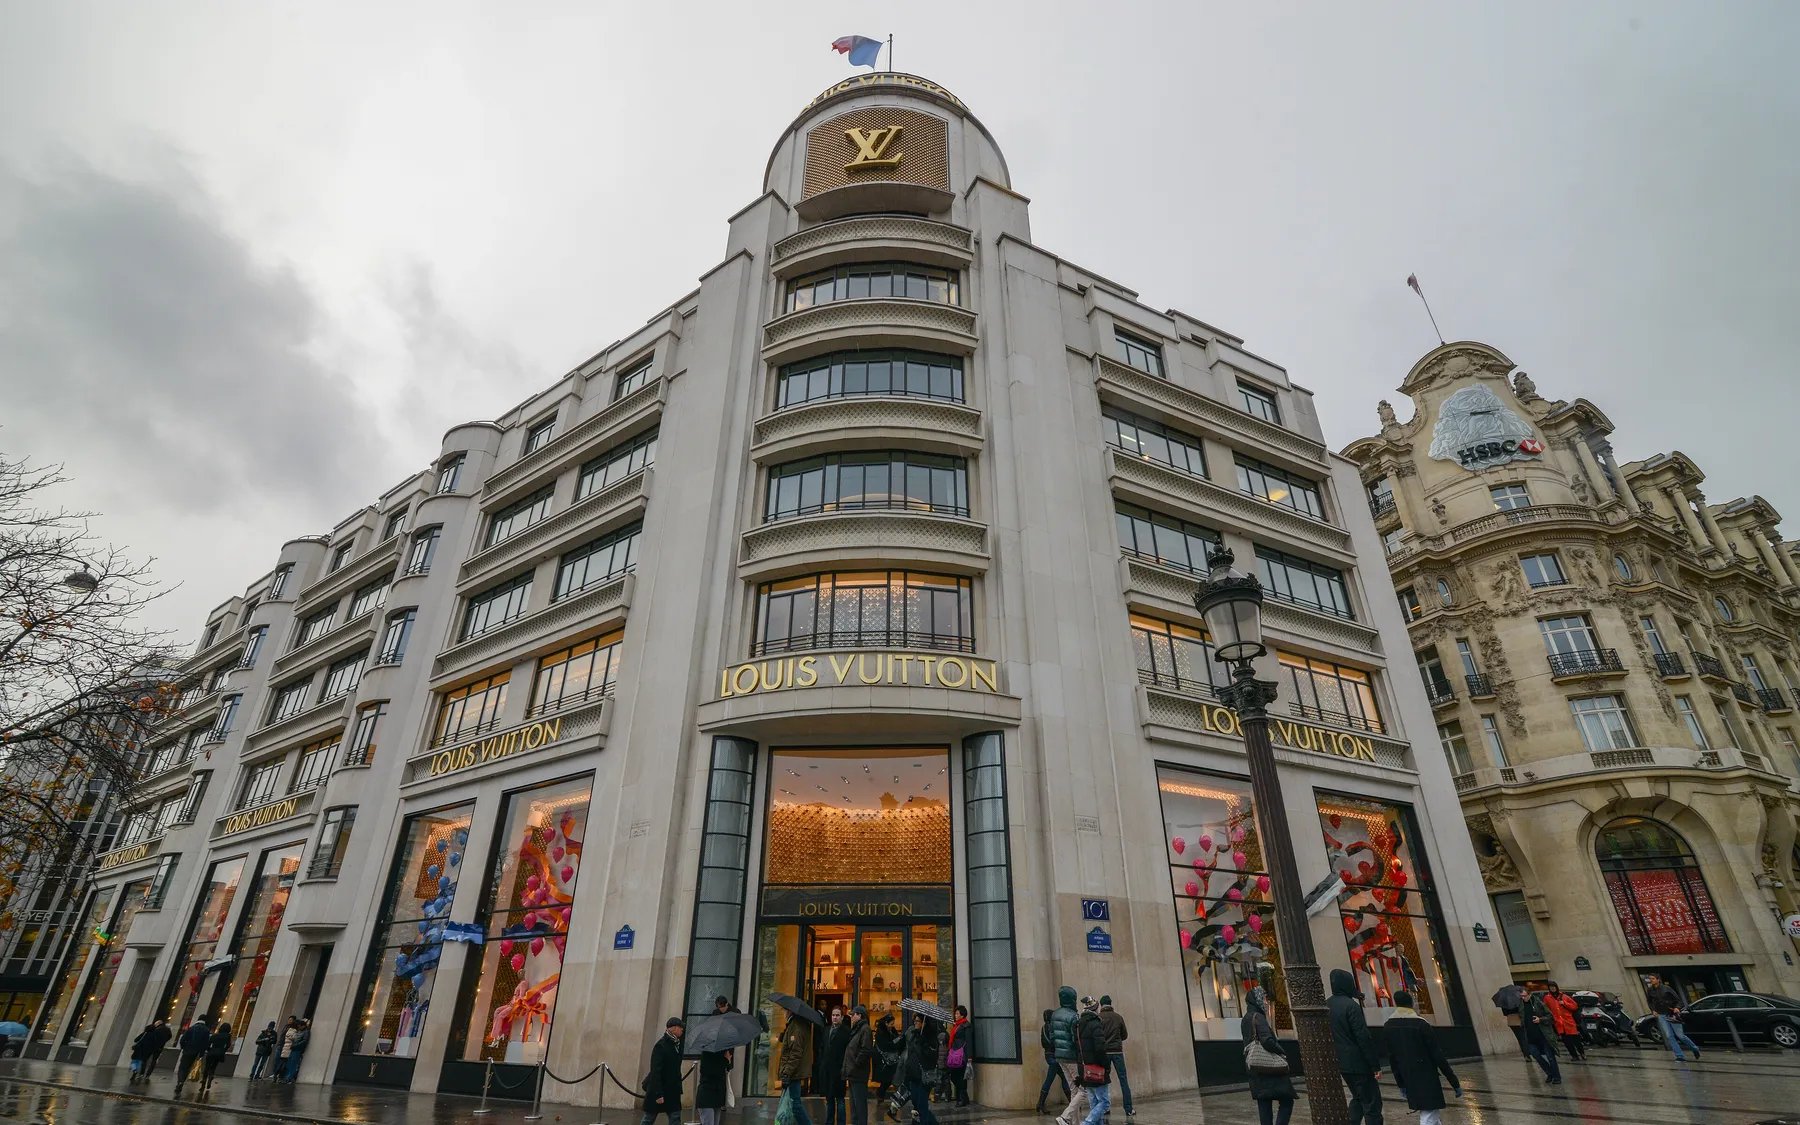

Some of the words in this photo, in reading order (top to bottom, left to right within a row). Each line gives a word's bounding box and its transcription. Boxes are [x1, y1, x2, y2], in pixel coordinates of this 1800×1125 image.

[1457, 439, 1517, 465] HSBC
[721, 656, 819, 698] LOUIS
[828, 654, 998, 693] VUITTON
[430, 743, 477, 777] LOUIS
[481, 718, 562, 763] VUITTON
[1277, 719, 1376, 762] VUITTON
[224, 812, 253, 834] LOUIS
[253, 799, 298, 826] VUITTON
[101, 852, 122, 869] LOUIS
[120, 844, 149, 863] VUITTON
[799, 902, 841, 916] LOUIS
[846, 902, 913, 916] VUITTON
[1083, 901, 1108, 919] 101
